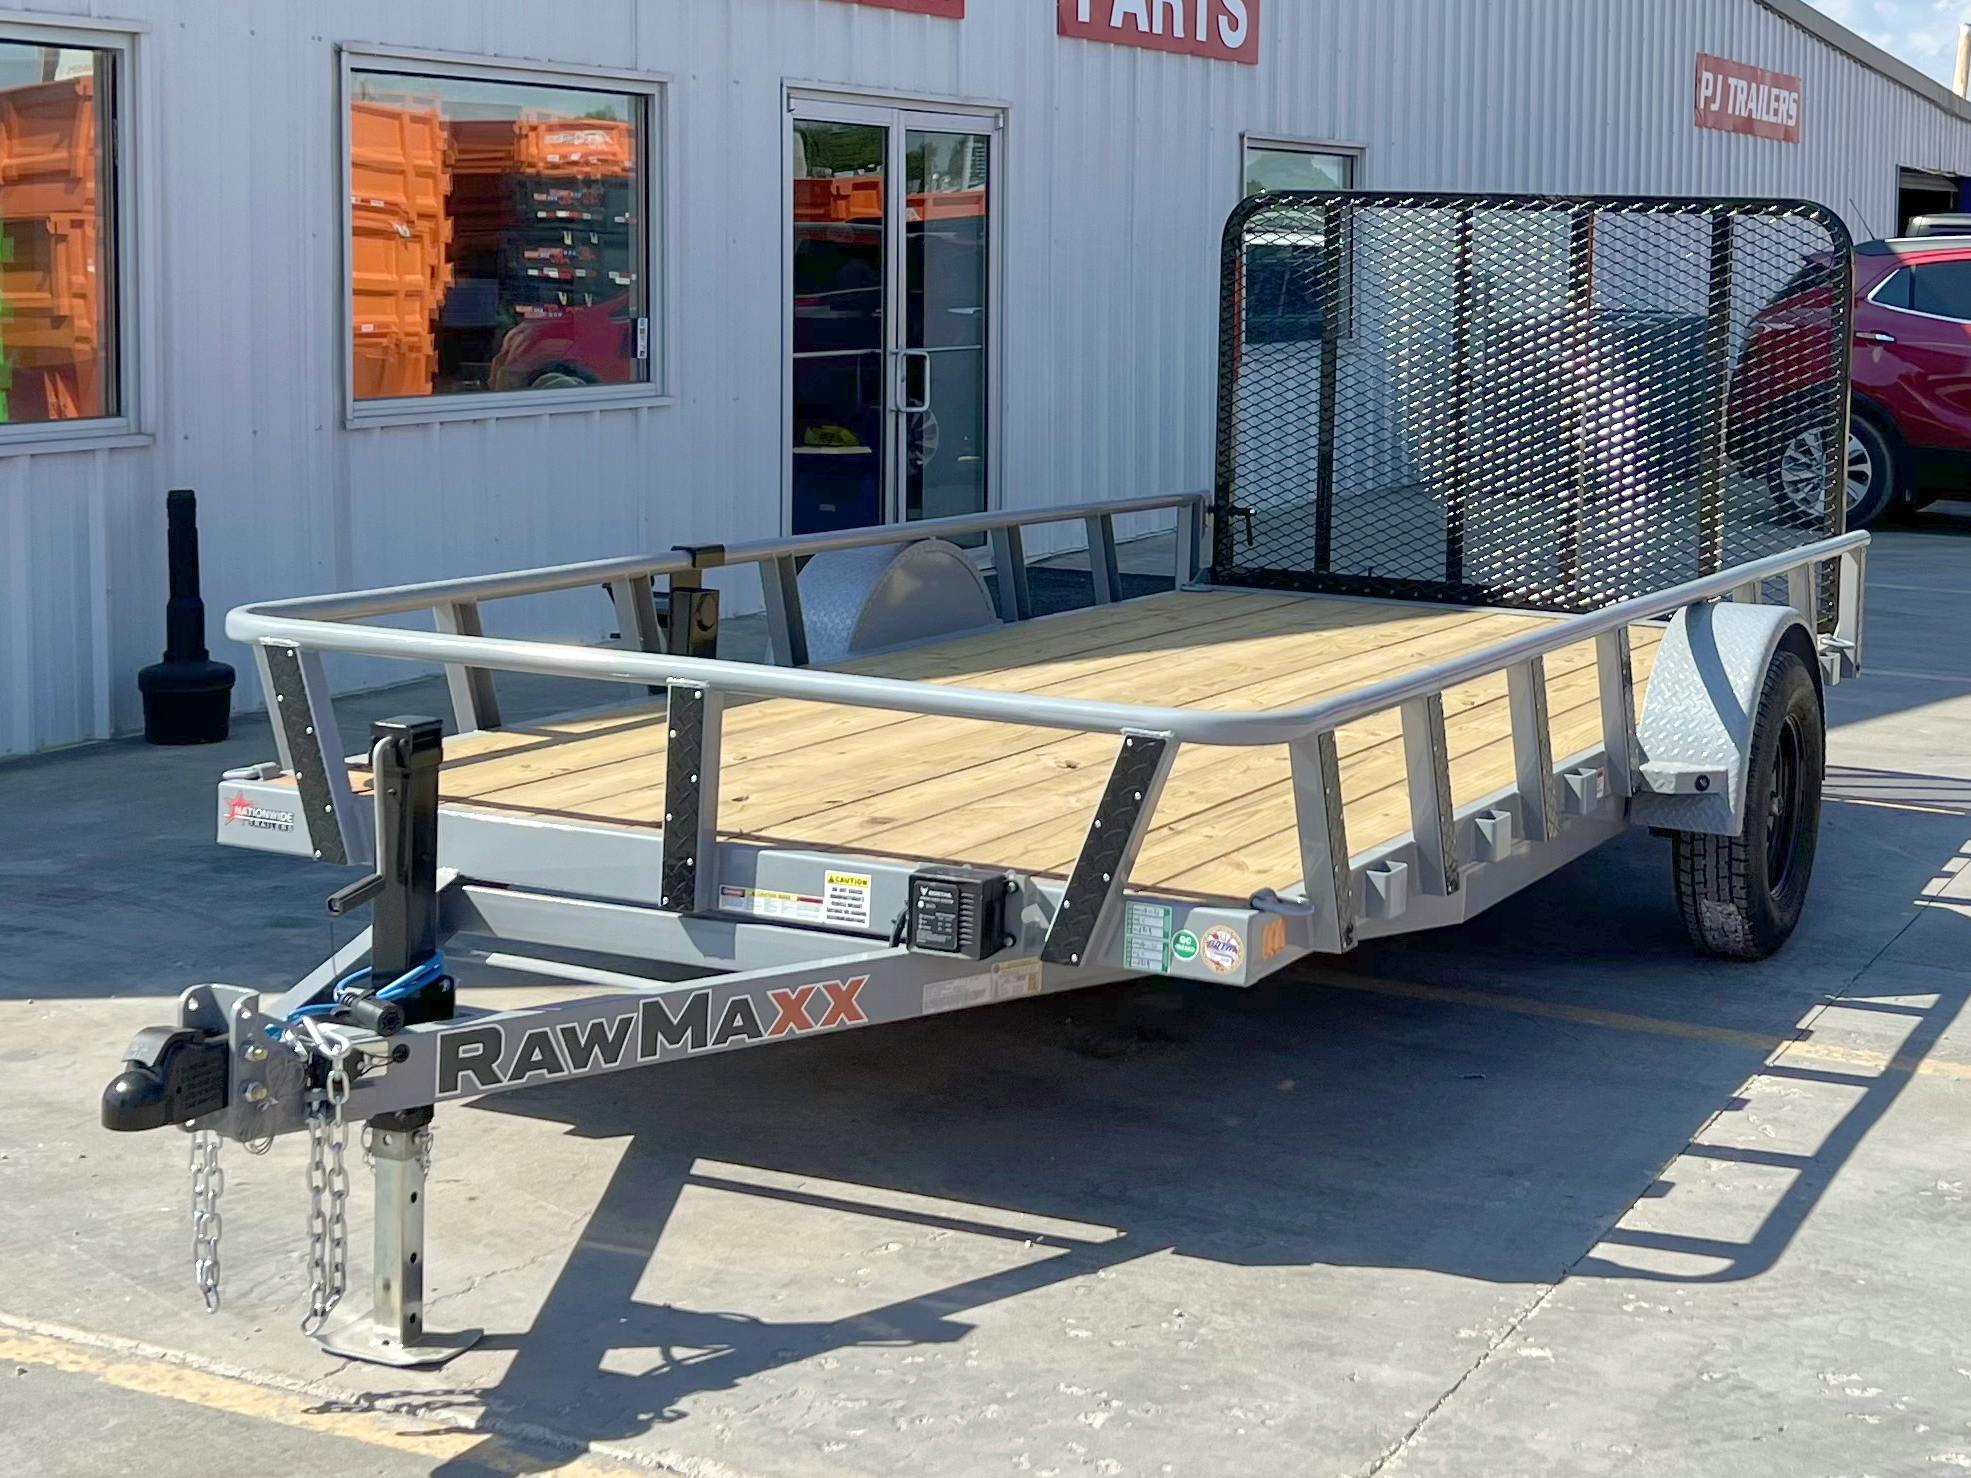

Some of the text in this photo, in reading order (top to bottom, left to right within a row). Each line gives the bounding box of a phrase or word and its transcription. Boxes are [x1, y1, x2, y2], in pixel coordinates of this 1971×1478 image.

[1700, 71, 1799, 127] PJ TRAILERS
[234, 805, 295, 823] NATIONWIDE
[835, 875, 868, 886] CAUTION
